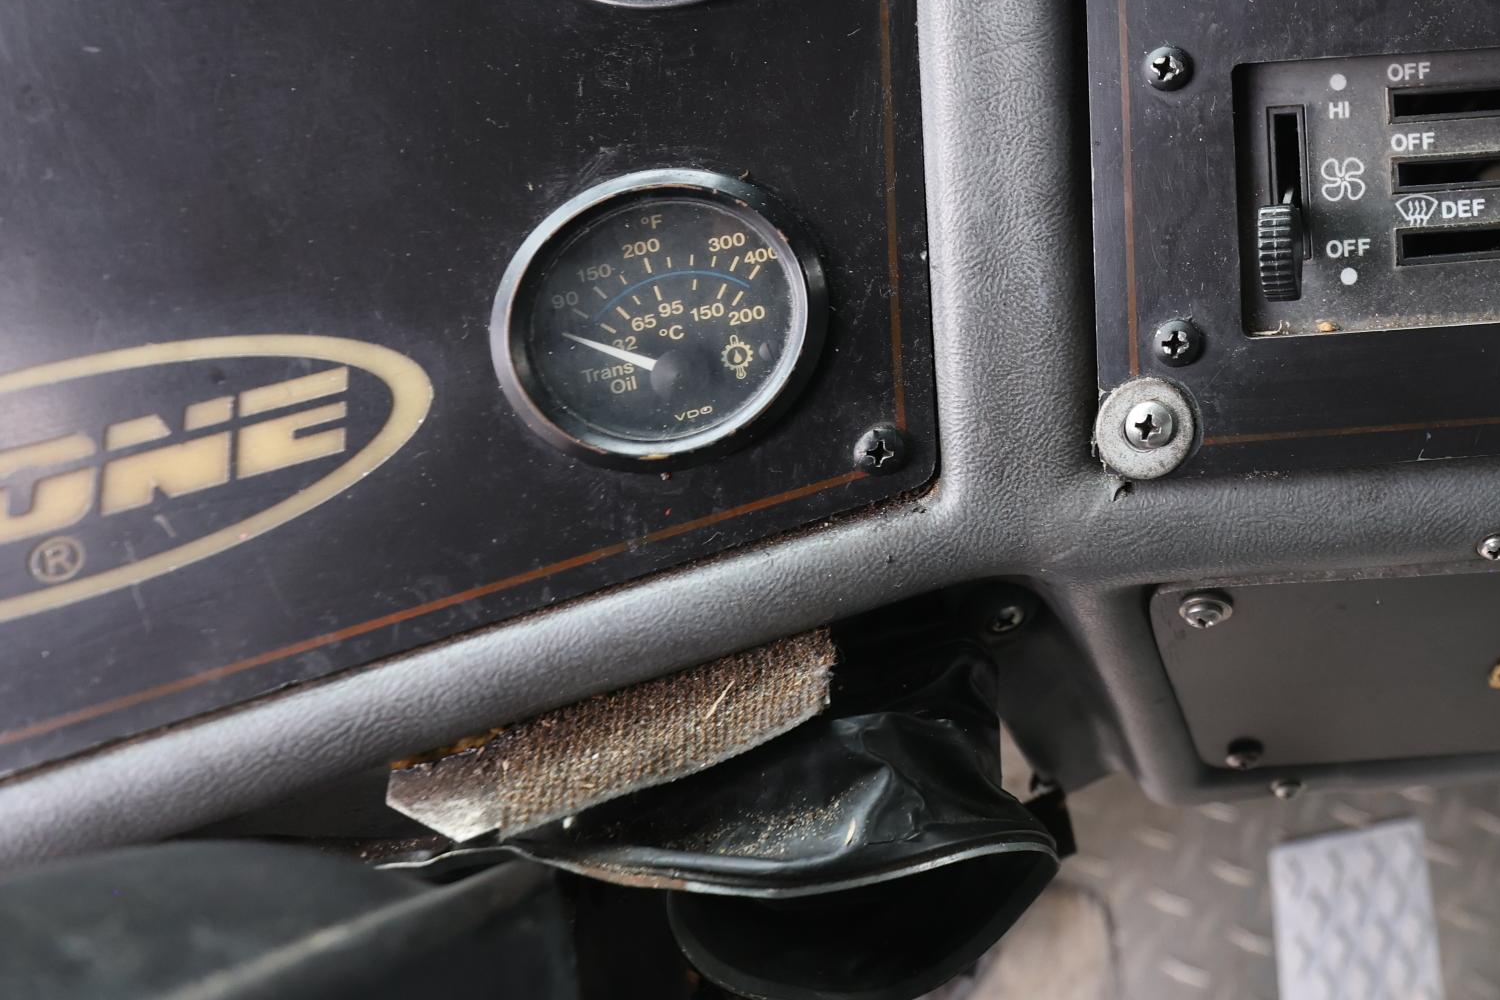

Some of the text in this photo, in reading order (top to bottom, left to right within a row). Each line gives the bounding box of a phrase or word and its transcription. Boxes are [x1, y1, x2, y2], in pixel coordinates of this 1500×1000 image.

[1386, 61, 1431, 82] OFF
[1328, 102, 1350, 120] HI
[1390, 132, 1436, 152] OFF
[1441, 199, 1486, 219] DEF
[622, 237, 660, 260] 200
[708, 231, 746, 253] 300
[1325, 238, 1371, 258] OFF
[577, 263, 612, 283] 150
[552, 290, 579, 310] 90
[658, 299, 684, 318] 95
[631, 313, 657, 332] 65
[690, 302, 725, 323] 150
[728, 304, 766, 327] 200
[581, 362, 635, 384] Trans
[610, 376, 637, 395] Oil
[674, 404, 713, 422] VDO
